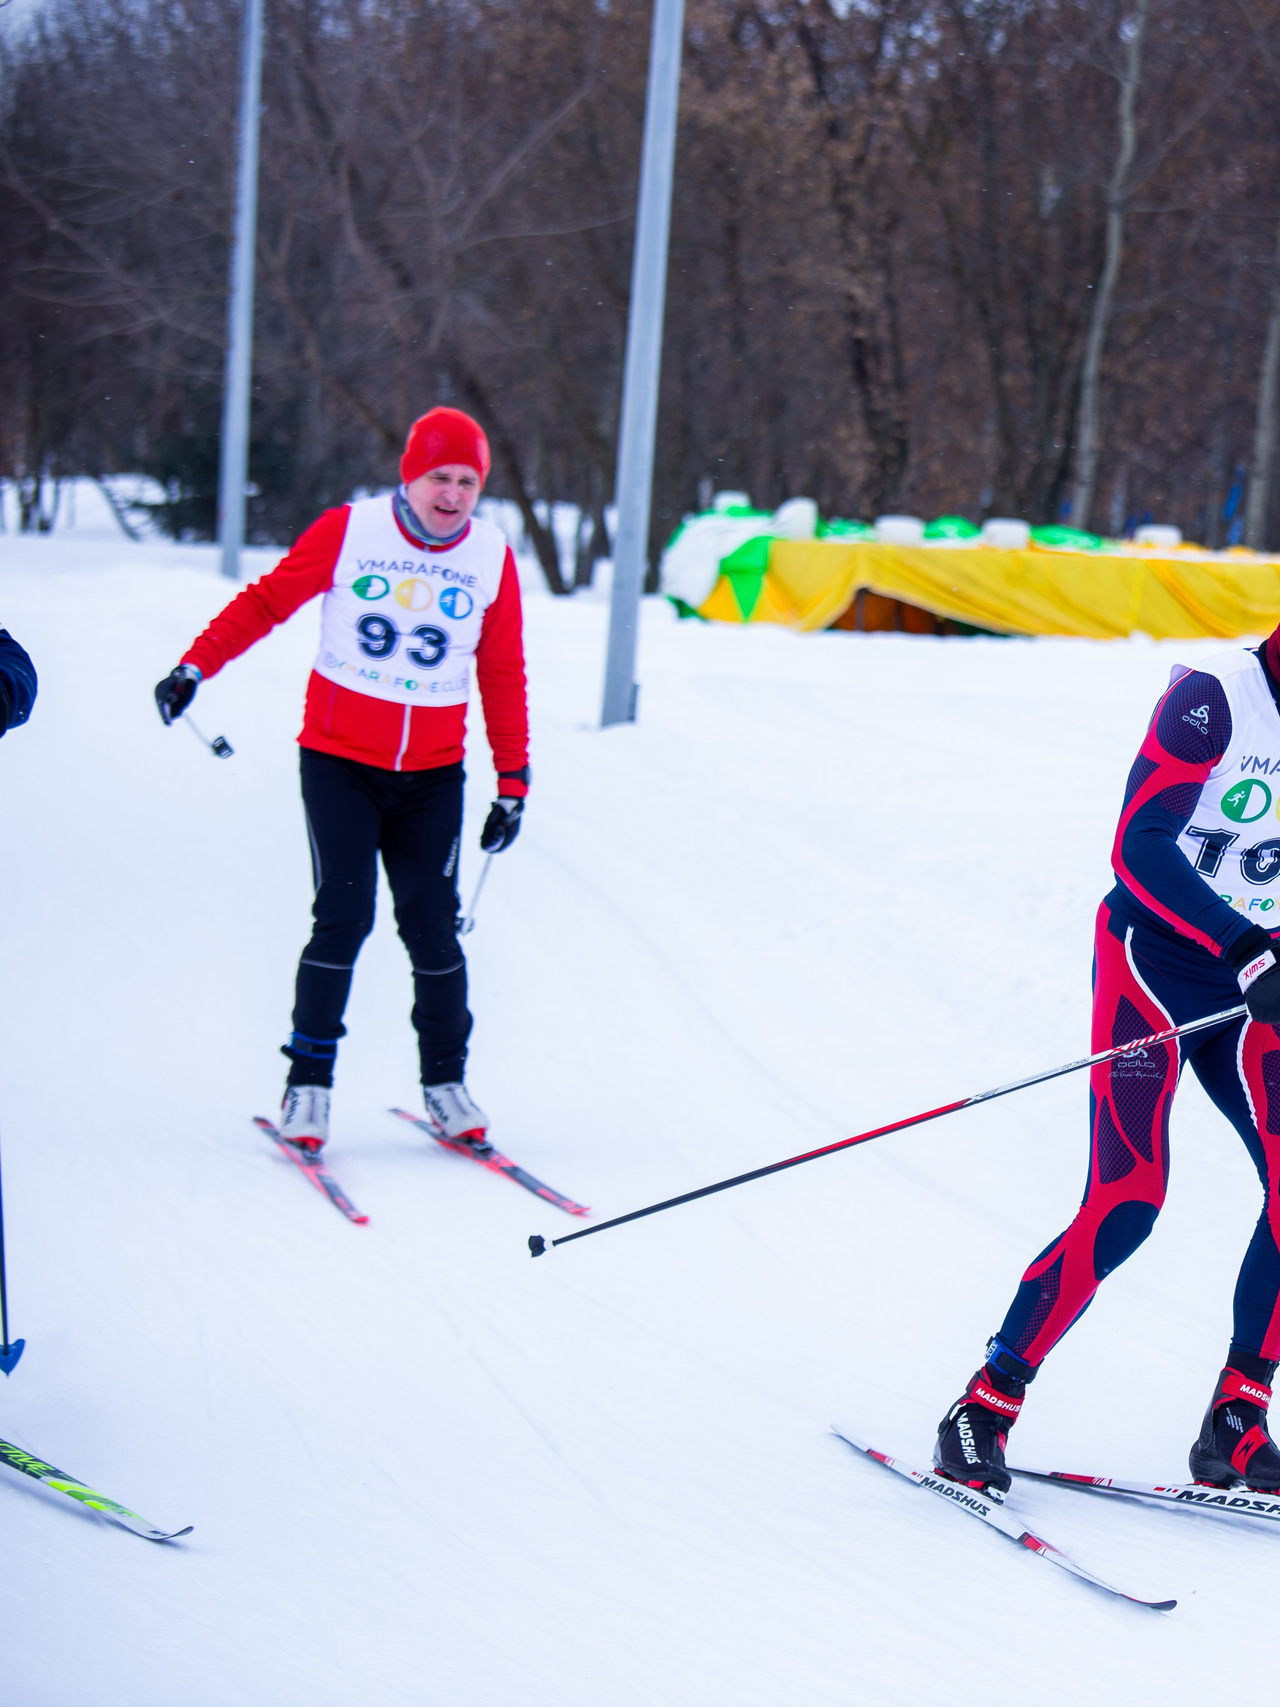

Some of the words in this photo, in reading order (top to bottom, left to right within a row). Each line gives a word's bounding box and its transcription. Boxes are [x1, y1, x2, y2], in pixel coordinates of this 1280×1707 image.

[357, 559, 477, 588] VMARAFONE
[356, 613, 450, 671] 93
[1182, 715, 1208, 734] odlo
[1118, 1060, 1155, 1068] odlo
[975, 1387, 1021, 1412] MADSHUS
[957, 1412, 981, 1465] MADSHUS
[920, 1477, 990, 1517] MADSHUS
